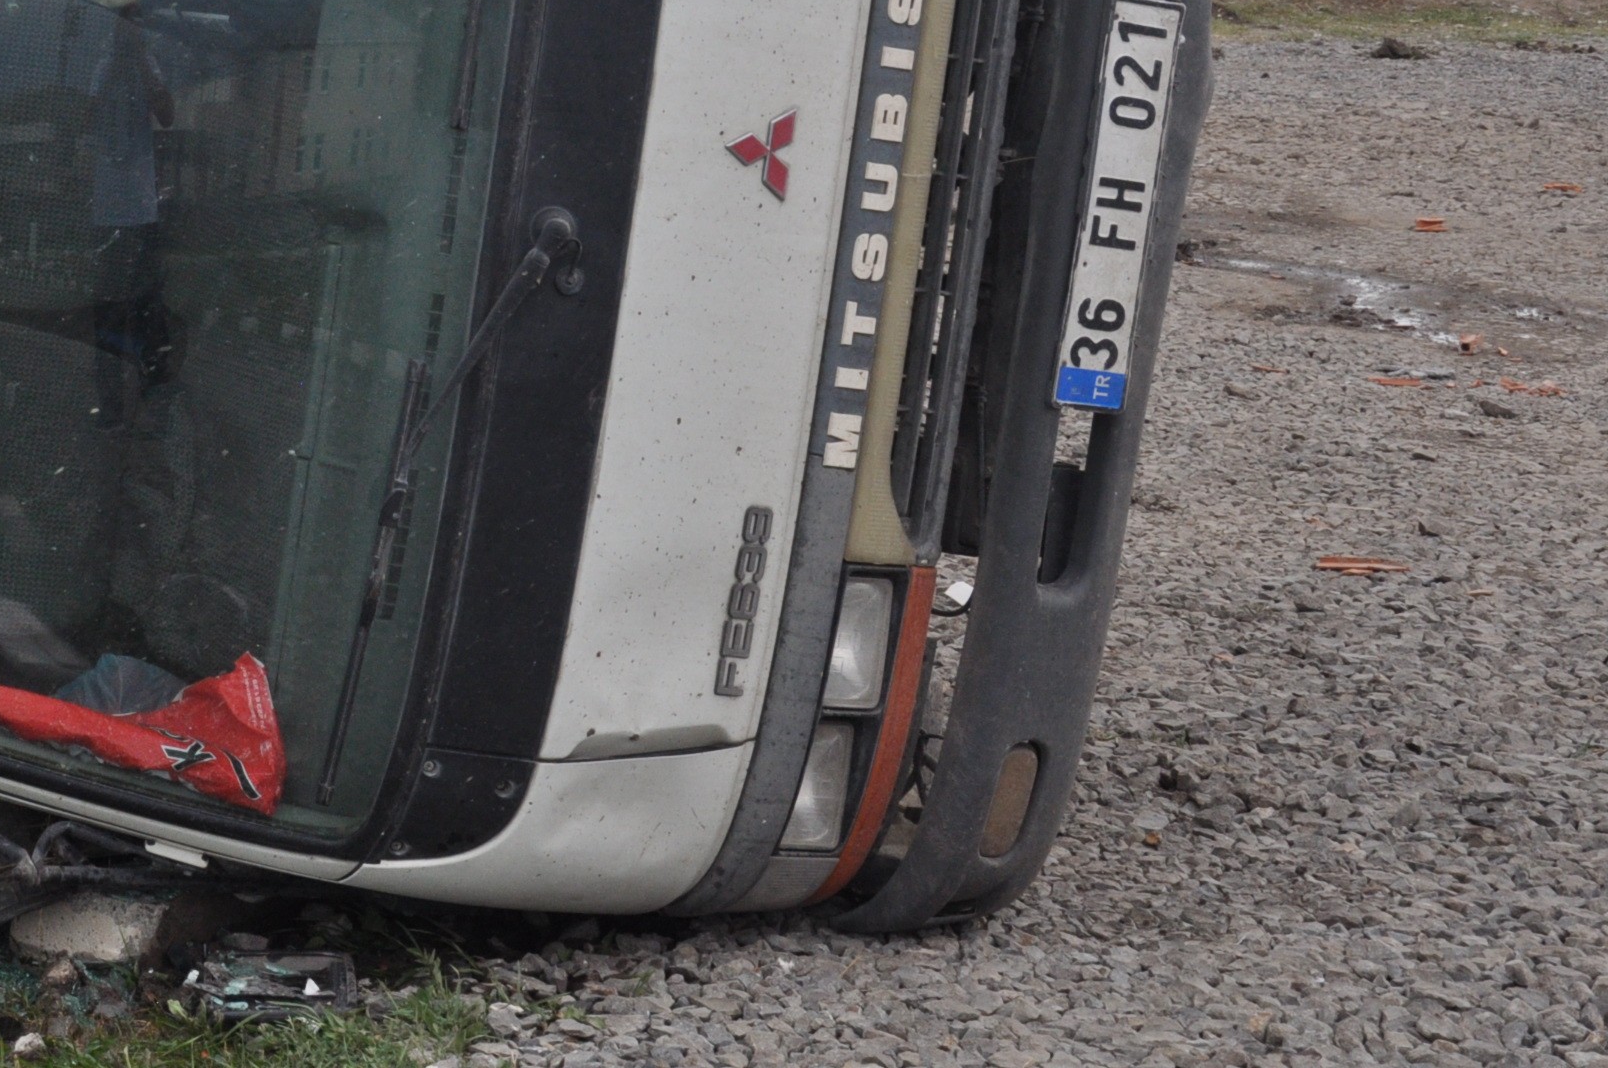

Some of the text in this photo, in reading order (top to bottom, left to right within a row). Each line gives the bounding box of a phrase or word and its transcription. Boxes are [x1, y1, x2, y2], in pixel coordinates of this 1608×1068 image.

[1070, 21, 1168, 370] 36 FH 021
[1092, 375, 1111, 400] TR
